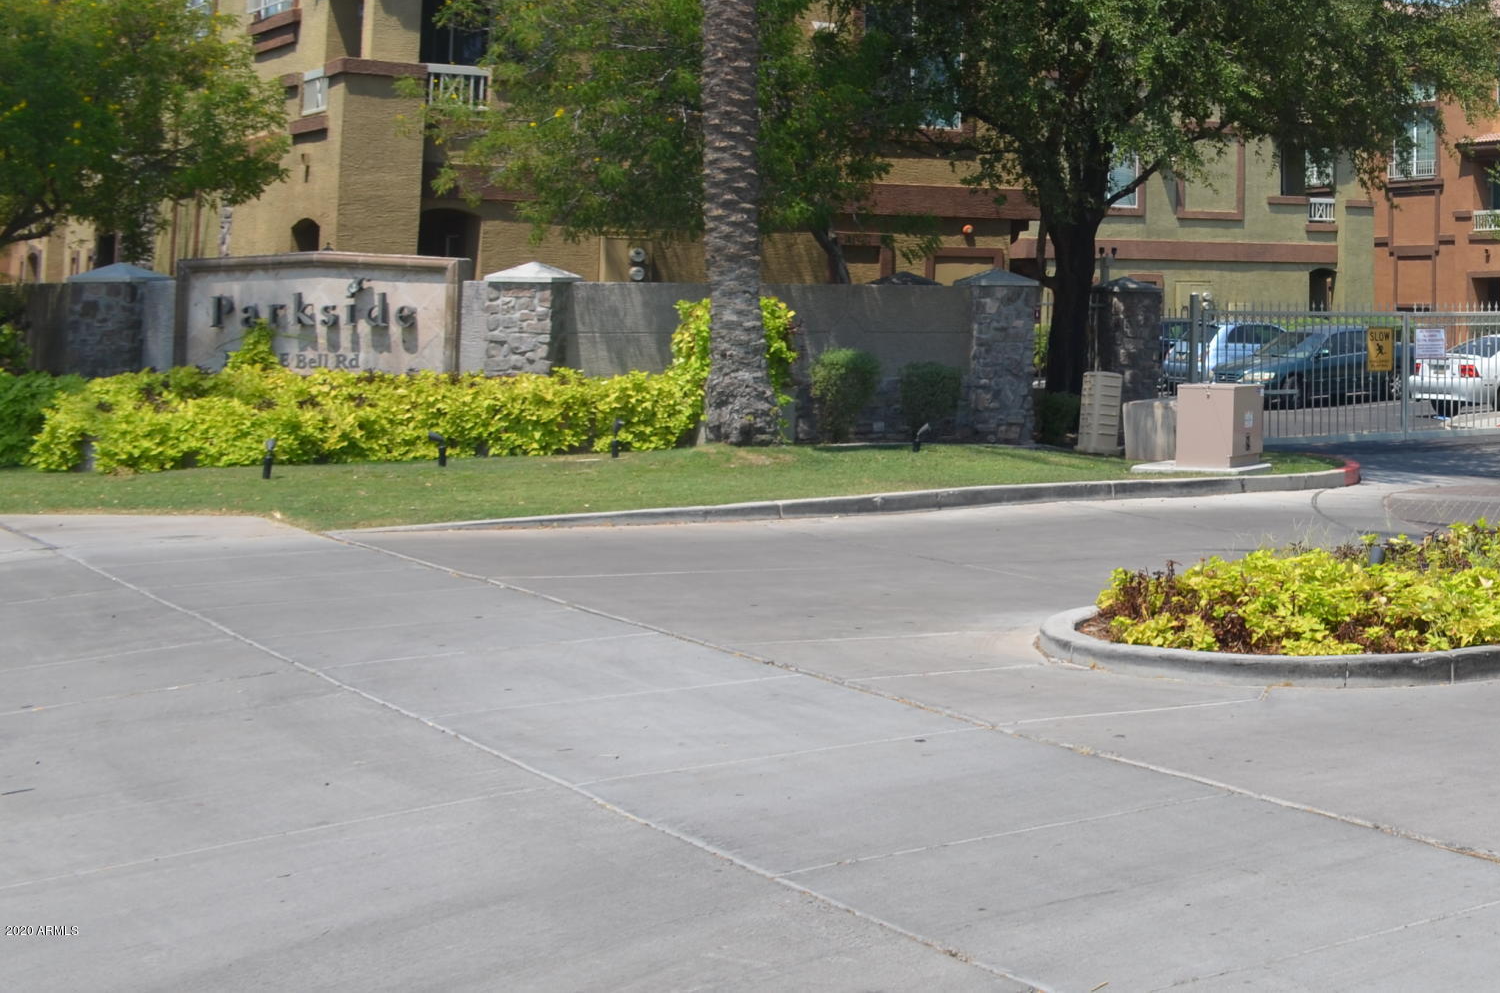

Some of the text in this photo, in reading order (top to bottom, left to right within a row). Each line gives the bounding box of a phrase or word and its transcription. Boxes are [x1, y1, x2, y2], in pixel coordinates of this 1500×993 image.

[209, 292, 418, 327] Parkside
[1369, 332, 1391, 342] SLOW
[296, 354, 329, 369] Bell
[335, 354, 360, 369] Rd
